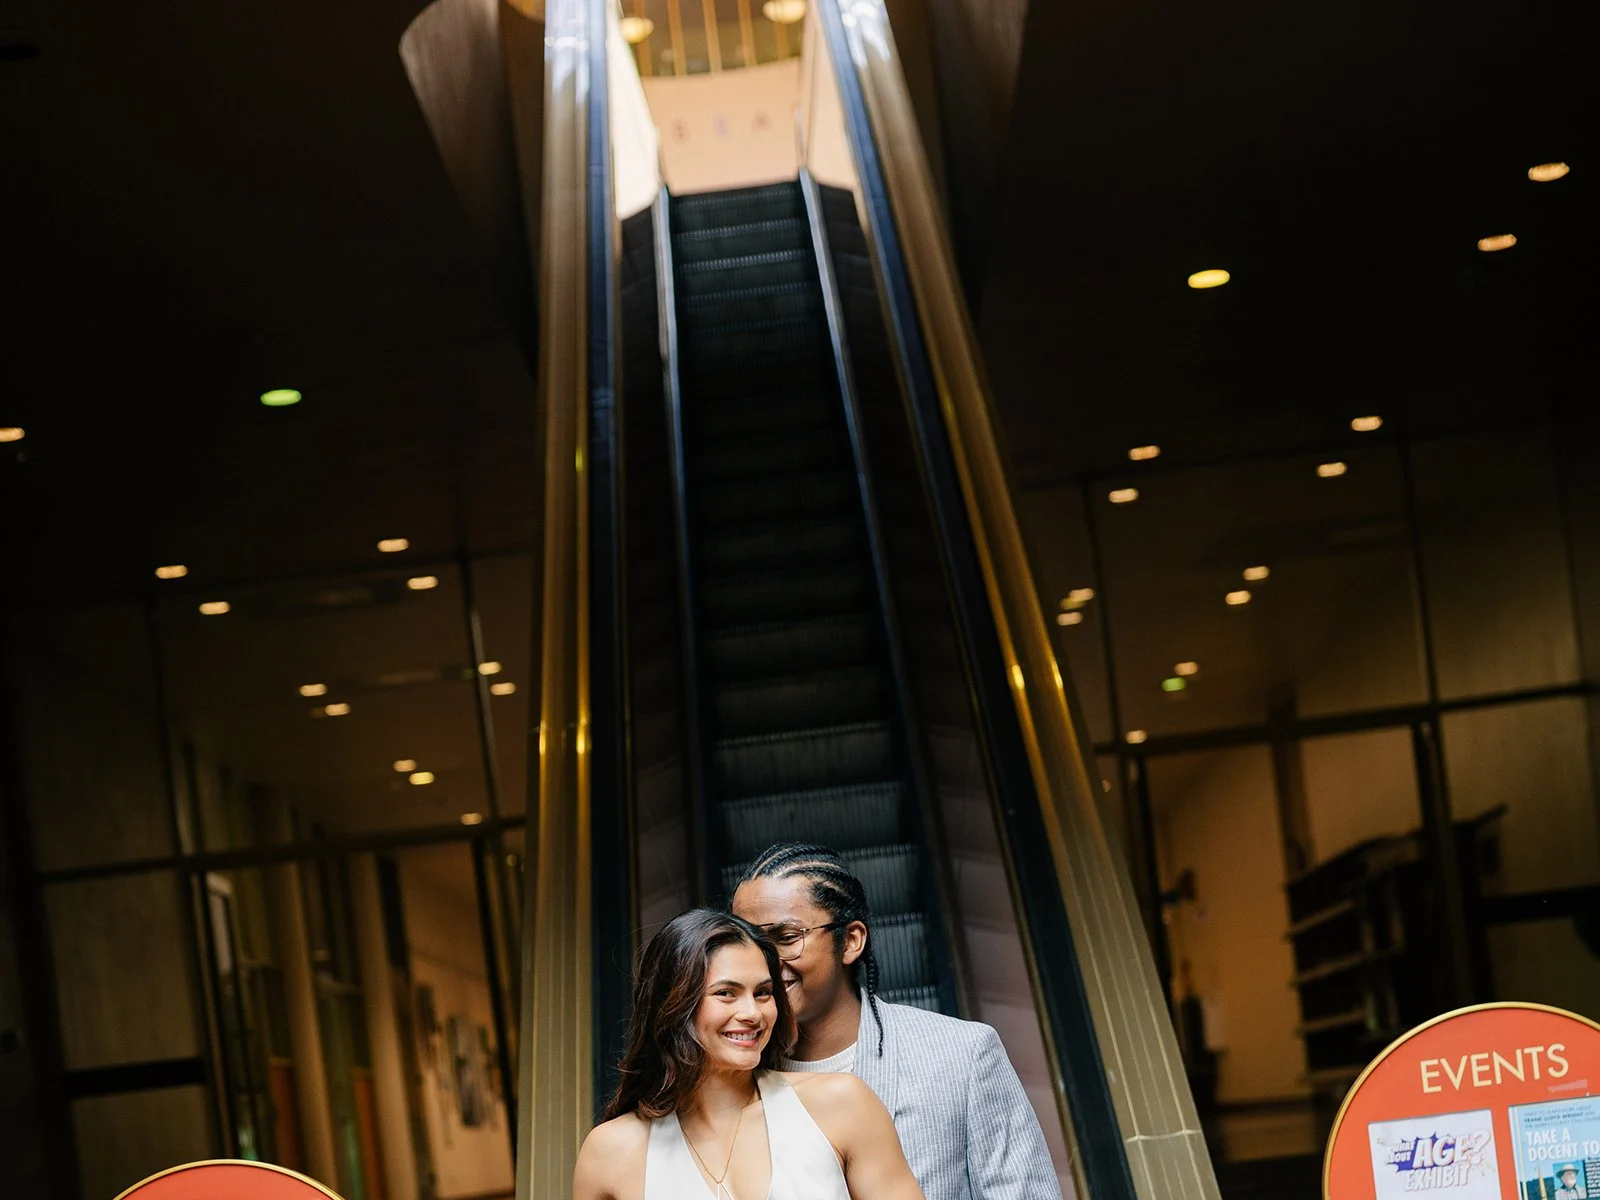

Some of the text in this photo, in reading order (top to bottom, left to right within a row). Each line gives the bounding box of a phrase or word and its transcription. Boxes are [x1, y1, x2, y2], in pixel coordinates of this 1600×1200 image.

[1420, 1043, 1570, 1094] EVENTS
[1525, 1128, 1571, 1146] TAKE A
[1528, 1142, 1578, 1162] DOCENT
[1405, 1164, 1472, 1192] EXHIBIT
